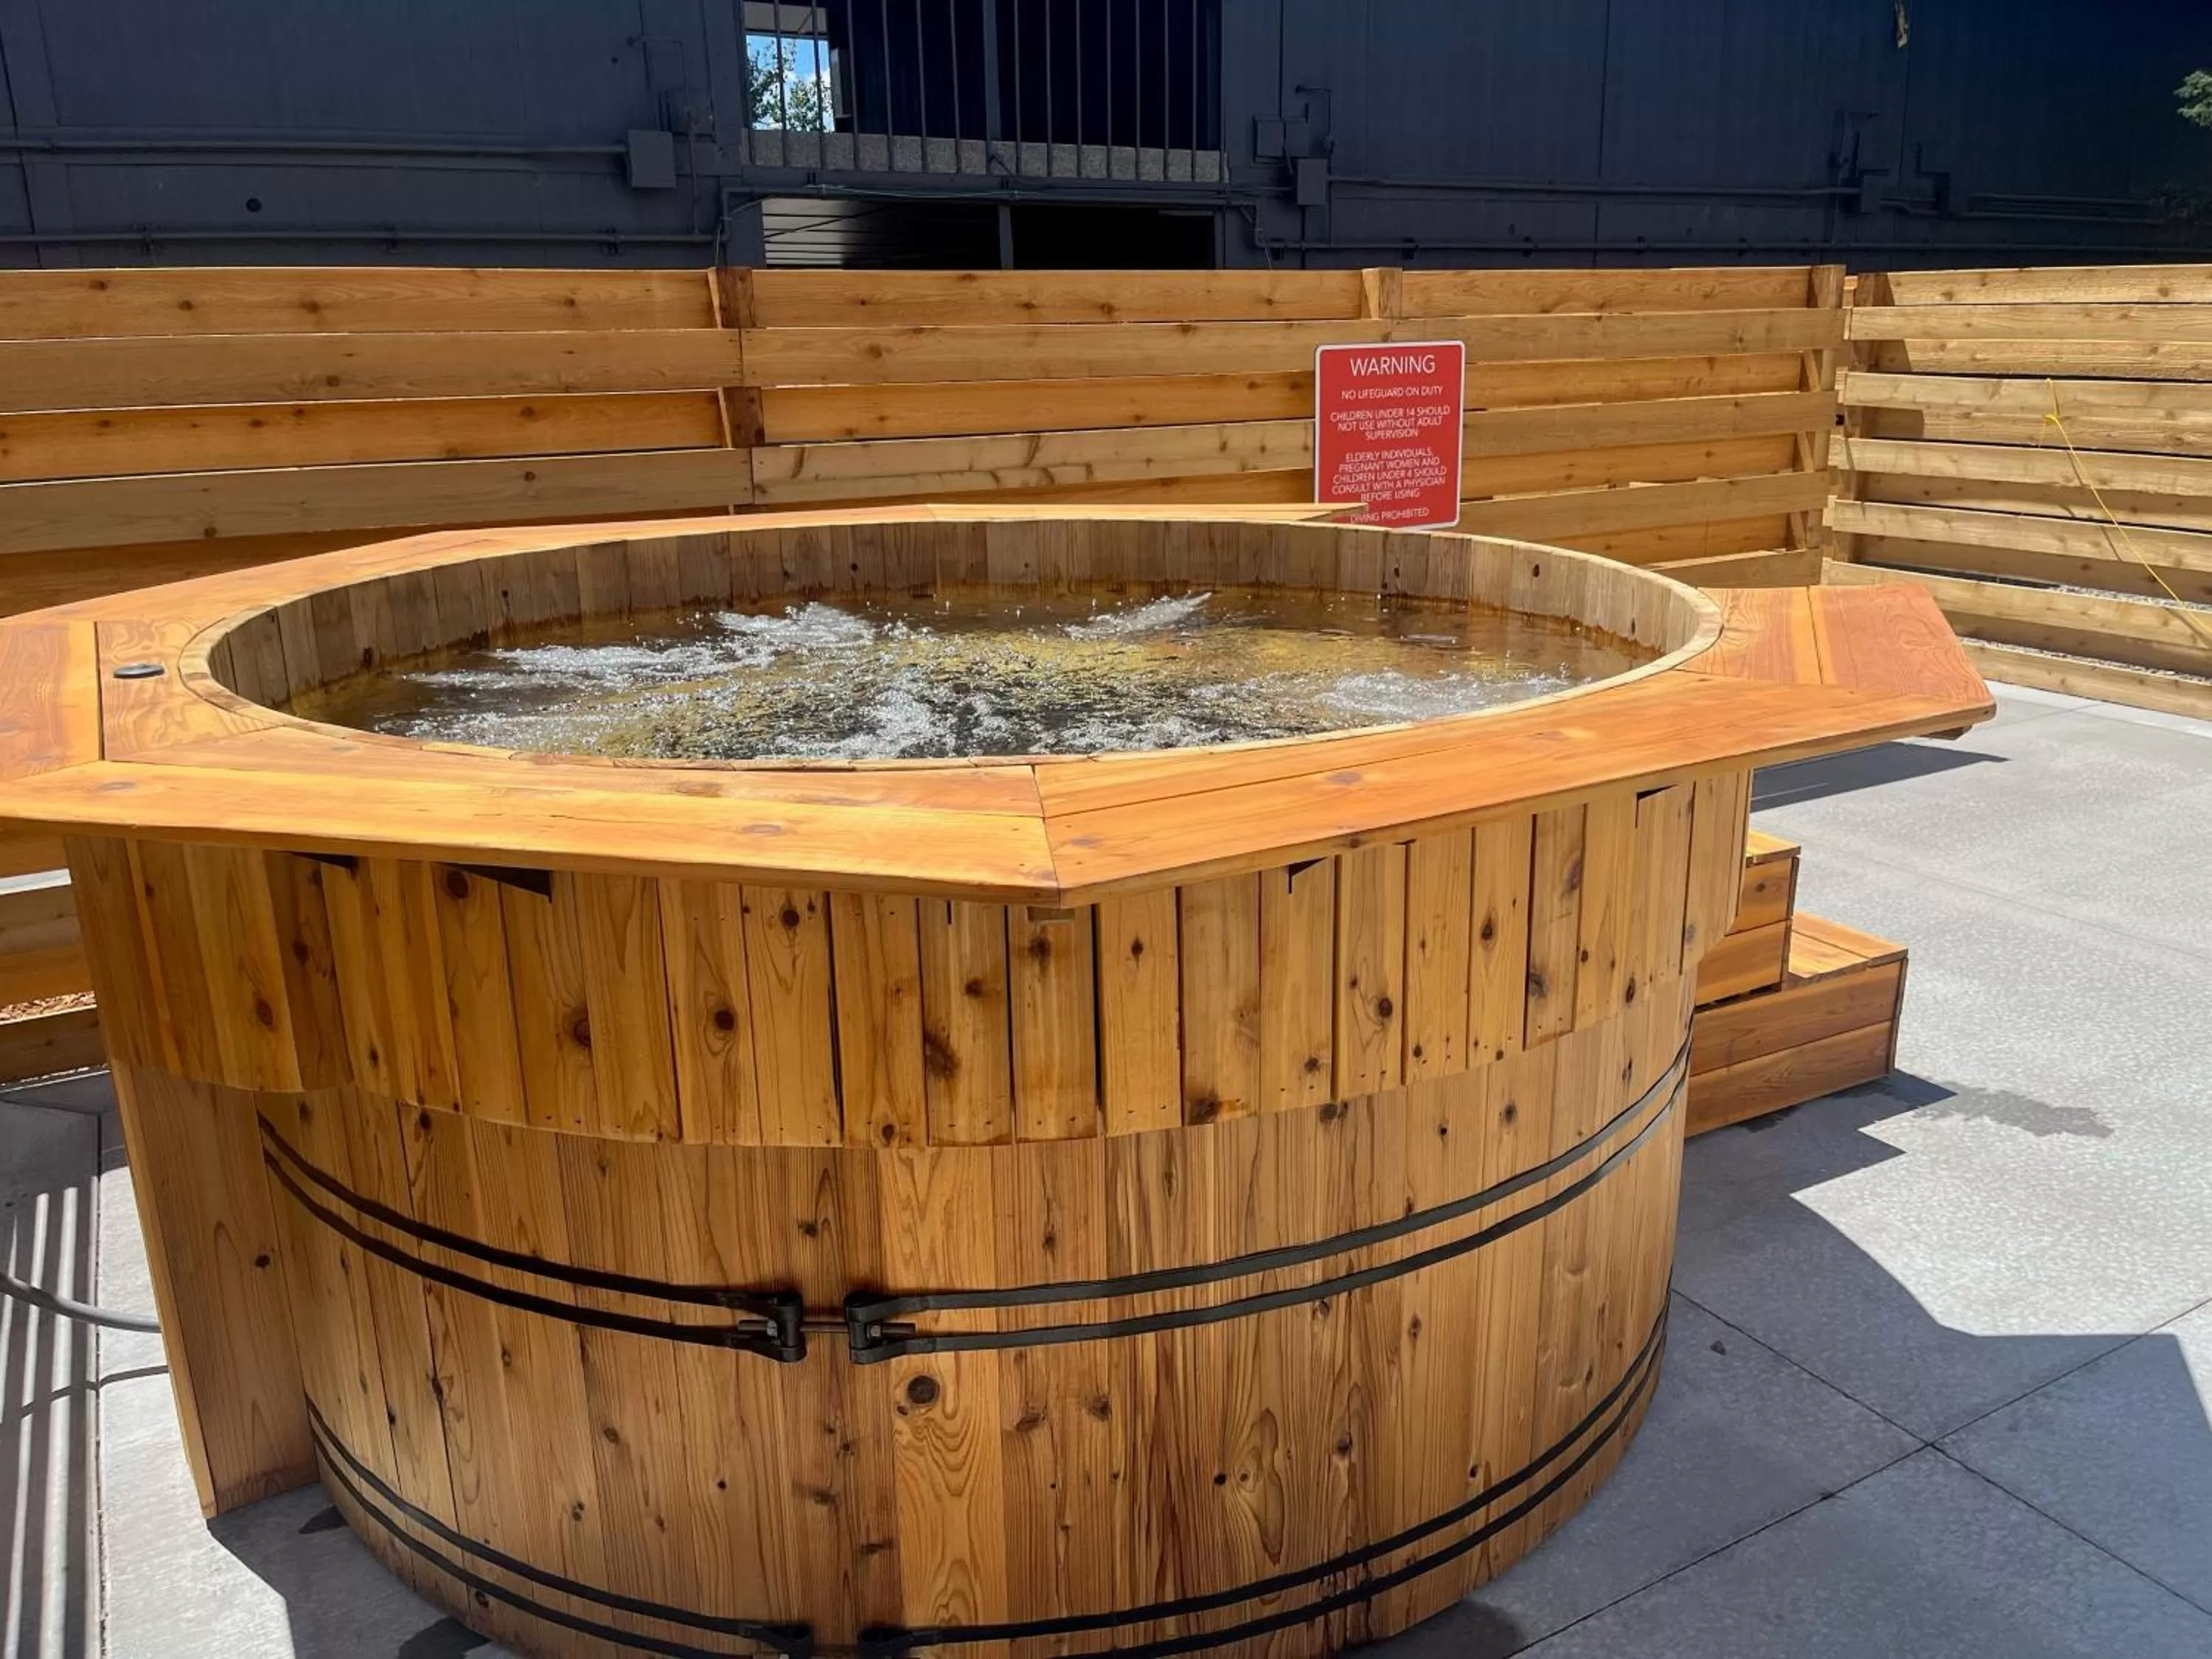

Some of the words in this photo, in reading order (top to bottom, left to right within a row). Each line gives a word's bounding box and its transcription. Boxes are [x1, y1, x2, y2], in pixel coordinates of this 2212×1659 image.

[1350, 355, 1436, 376] WARNING
[1341, 390, 1356, 400] NO
[1358, 387, 1403, 399] LIFEGUARD
[1405, 386, 1419, 396] ON
[1422, 386, 1443, 395] DUTY
[1330, 409, 1373, 422] CHILDREN
[1376, 408, 1403, 420] UNDER
[1407, 408, 1416, 417] 14
[1416, 406, 1450, 417] SHOULD
[1338, 422, 1357, 431] NOT
[1359, 420, 1374, 430] USE
[1377, 418, 1415, 428] WITHOUT
[1417, 417, 1442, 425] ADULT
[1365, 428, 1419, 439] SUPERVISION
[1346, 451, 1380, 462] ELDERLY
[1339, 461, 1385, 473] PREGNANT
[1386, 458, 1419, 469] WOMEN
[1421, 456, 1439, 466] AND
[1333, 472, 1375, 484] CHILDREN
[1377, 470, 1405, 480] UNDER
[1414, 466, 1447, 476] SHOULD
[1332, 483, 1370, 495] CONSULT
[1373, 481, 1394, 491] WITH
[1396, 481, 1402, 489] A
[1404, 477, 1445, 487] PHYSICIAN
[1360, 491, 1393, 502] BEFORE
[1394, 488, 1420, 498] USING
[1382, 507, 1430, 520] PROHIBITED
